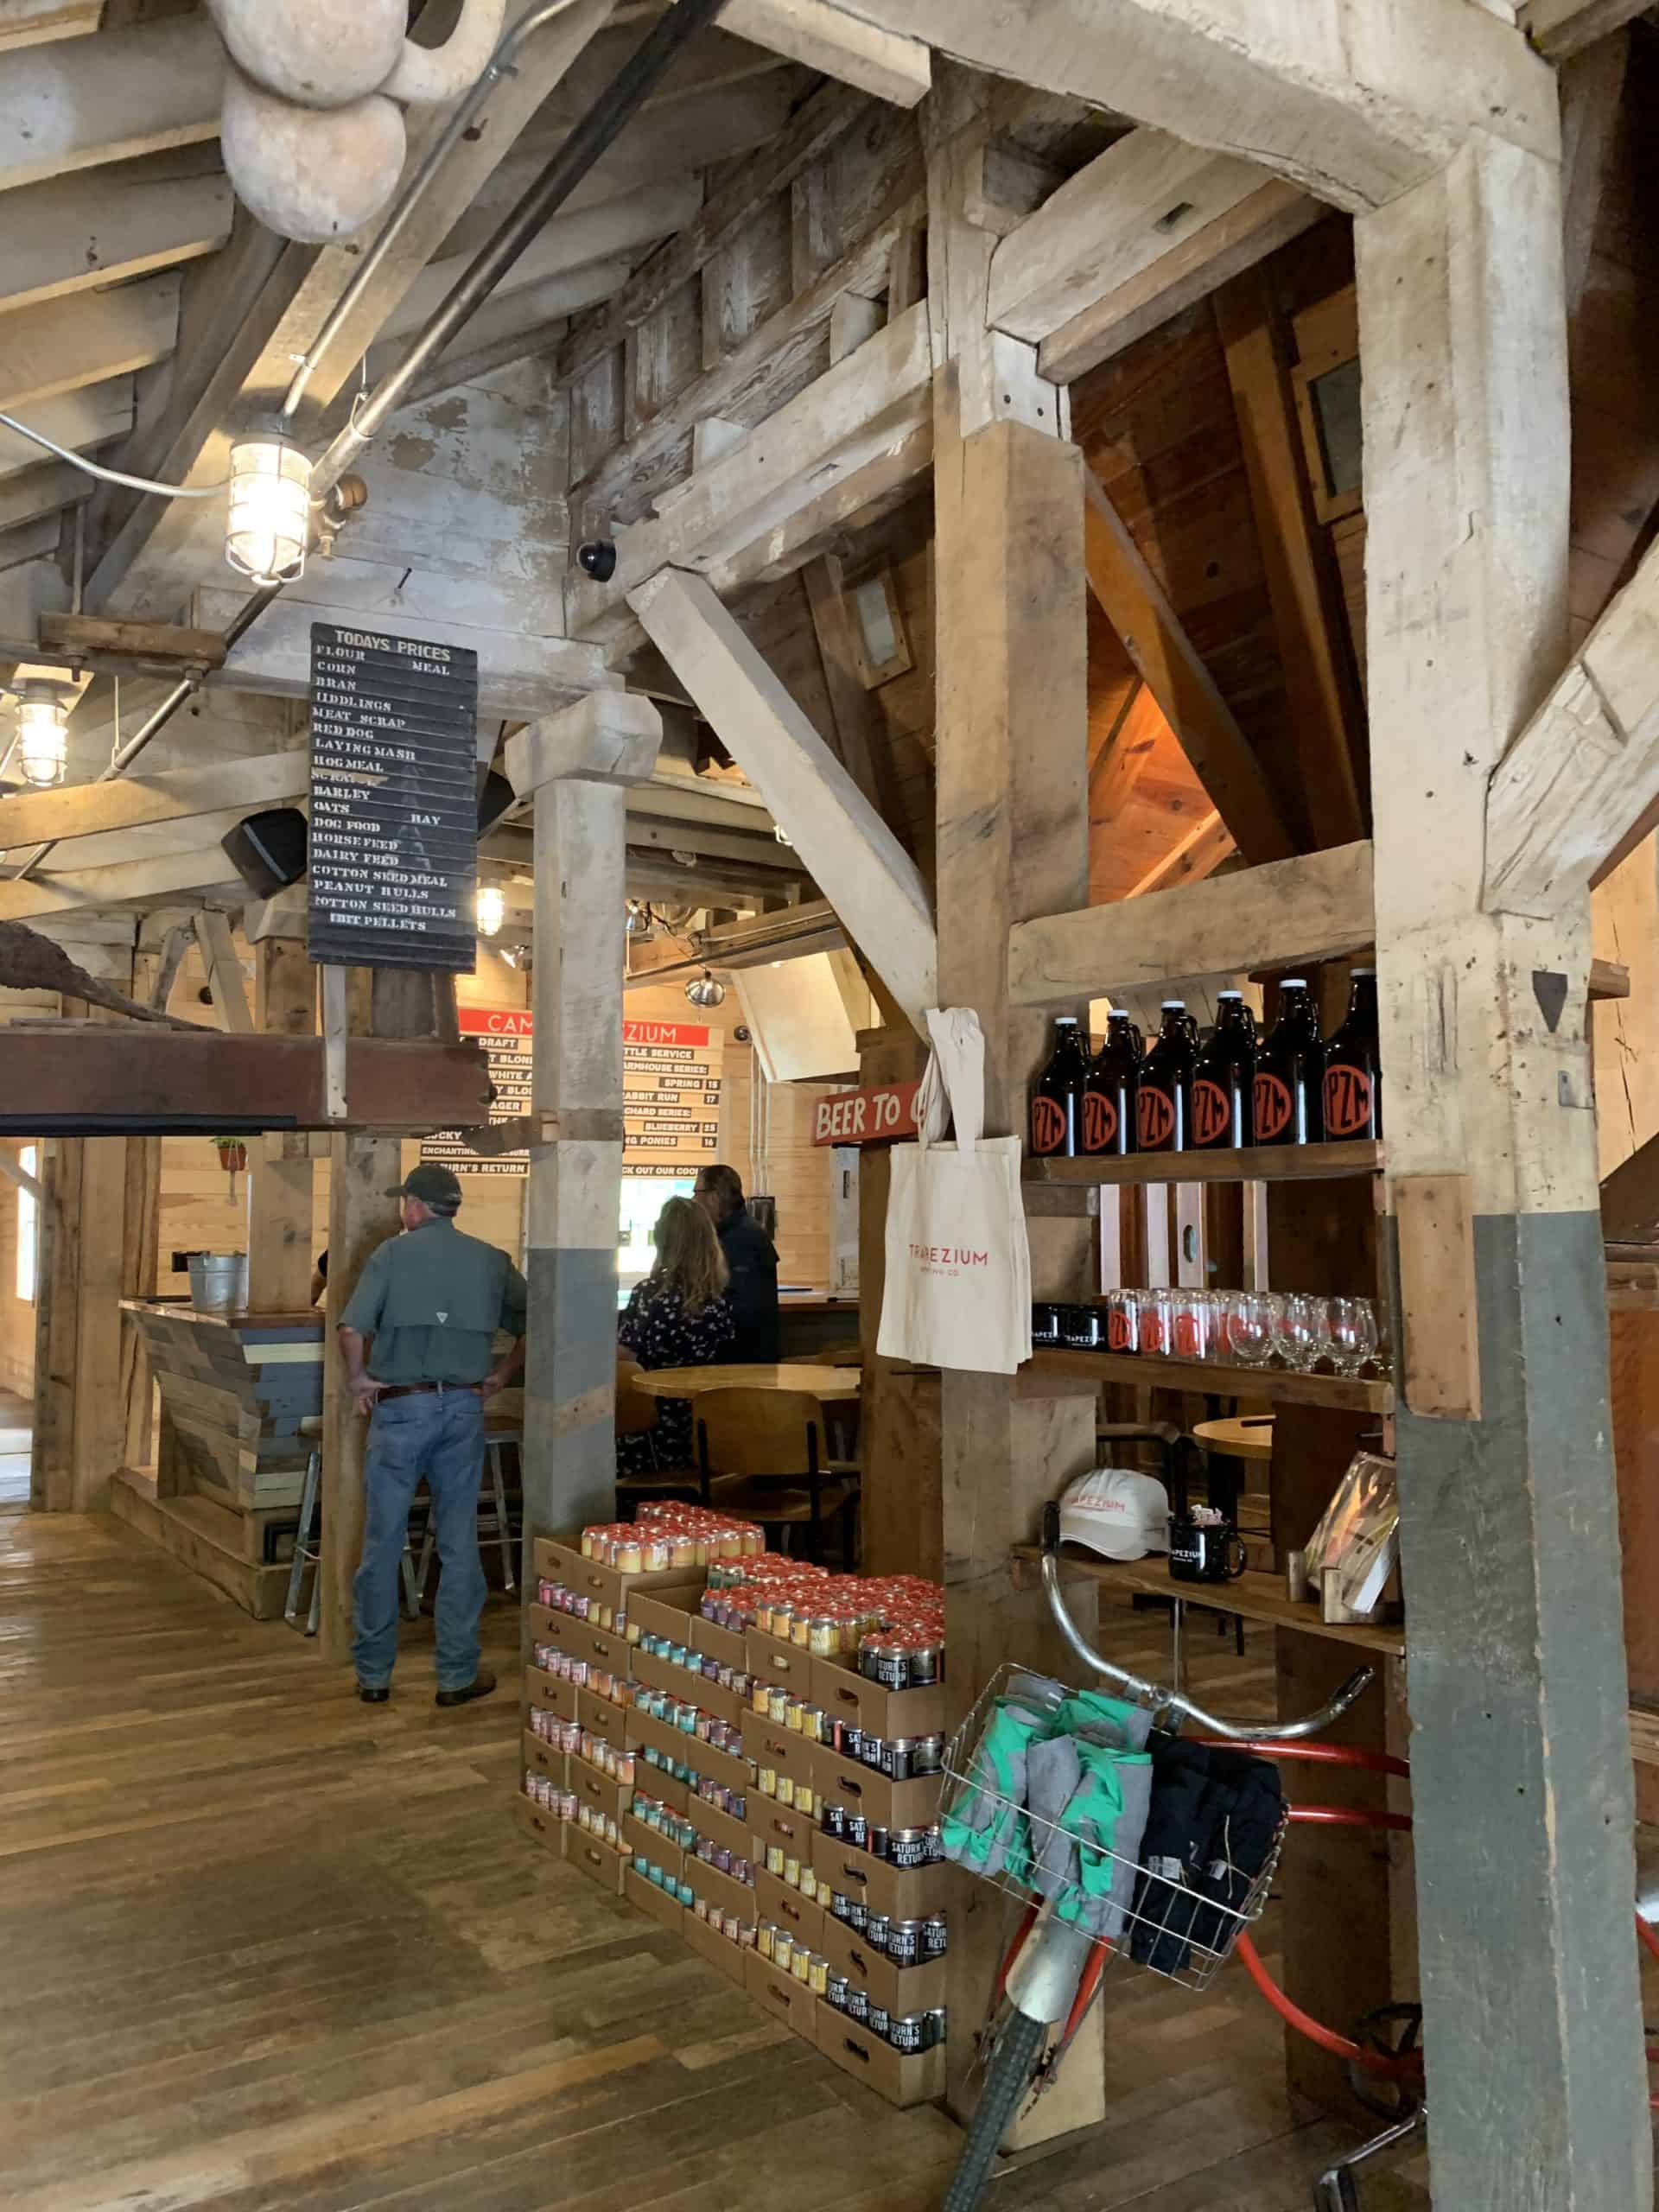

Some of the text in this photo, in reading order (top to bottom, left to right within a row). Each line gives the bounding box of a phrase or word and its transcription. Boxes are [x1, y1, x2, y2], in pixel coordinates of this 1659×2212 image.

[316, 645, 365, 661] FLOUR
[335, 630, 450, 662] TODAYS PRICES
[317, 661, 356, 675] CORN
[412, 660, 449, 676] MEAL
[360, 715, 406, 728] SCRAP
[314, 722, 374, 740] RED DOG
[315, 738, 416, 761] LAYING MASH
[314, 754, 385, 772] HOG MEAL
[314, 785, 371, 800] BARLEY
[314, 801, 350, 813] OATS
[314, 817, 381, 832] DOG FOOD
[410, 813, 441, 825] HAY
[313, 832, 398, 851] HORSE FEED
[314, 849, 399, 866] DAIRY FEED
[313, 865, 369, 879] COTTON
[372, 871, 408, 883] SEED
[314, 880, 429, 899] PEANUT HULLS
[372, 901, 409, 914] SEED
[410, 905, 457, 918] HULLS
[364, 914, 426, 931] PELLETS
[622, 1023, 677, 1044] ZIUM
[479, 1037, 516, 1048] DRAFT
[652, 1049, 692, 1060] SERVICE
[488, 1070, 523, 1080] WHITE
[664, 1078, 701, 1089] SPRING
[623, 1091, 678, 1103] ABBIT RUN
[707, 1095, 716, 1103] 17
[816, 1096, 867, 1141] BEER
[872, 1092, 901, 1131] TO
[645, 1122, 698, 1133] BLUEBERRY
[640, 1136, 677, 1147] PONIES
[704, 1138, 714, 1147] 16
[481, 1164, 525, 1173] RETURN
[636, 1166, 654, 1175] OUT
[655, 1167, 674, 1176] OUR
[889, 1943, 915, 1956] ETURN
